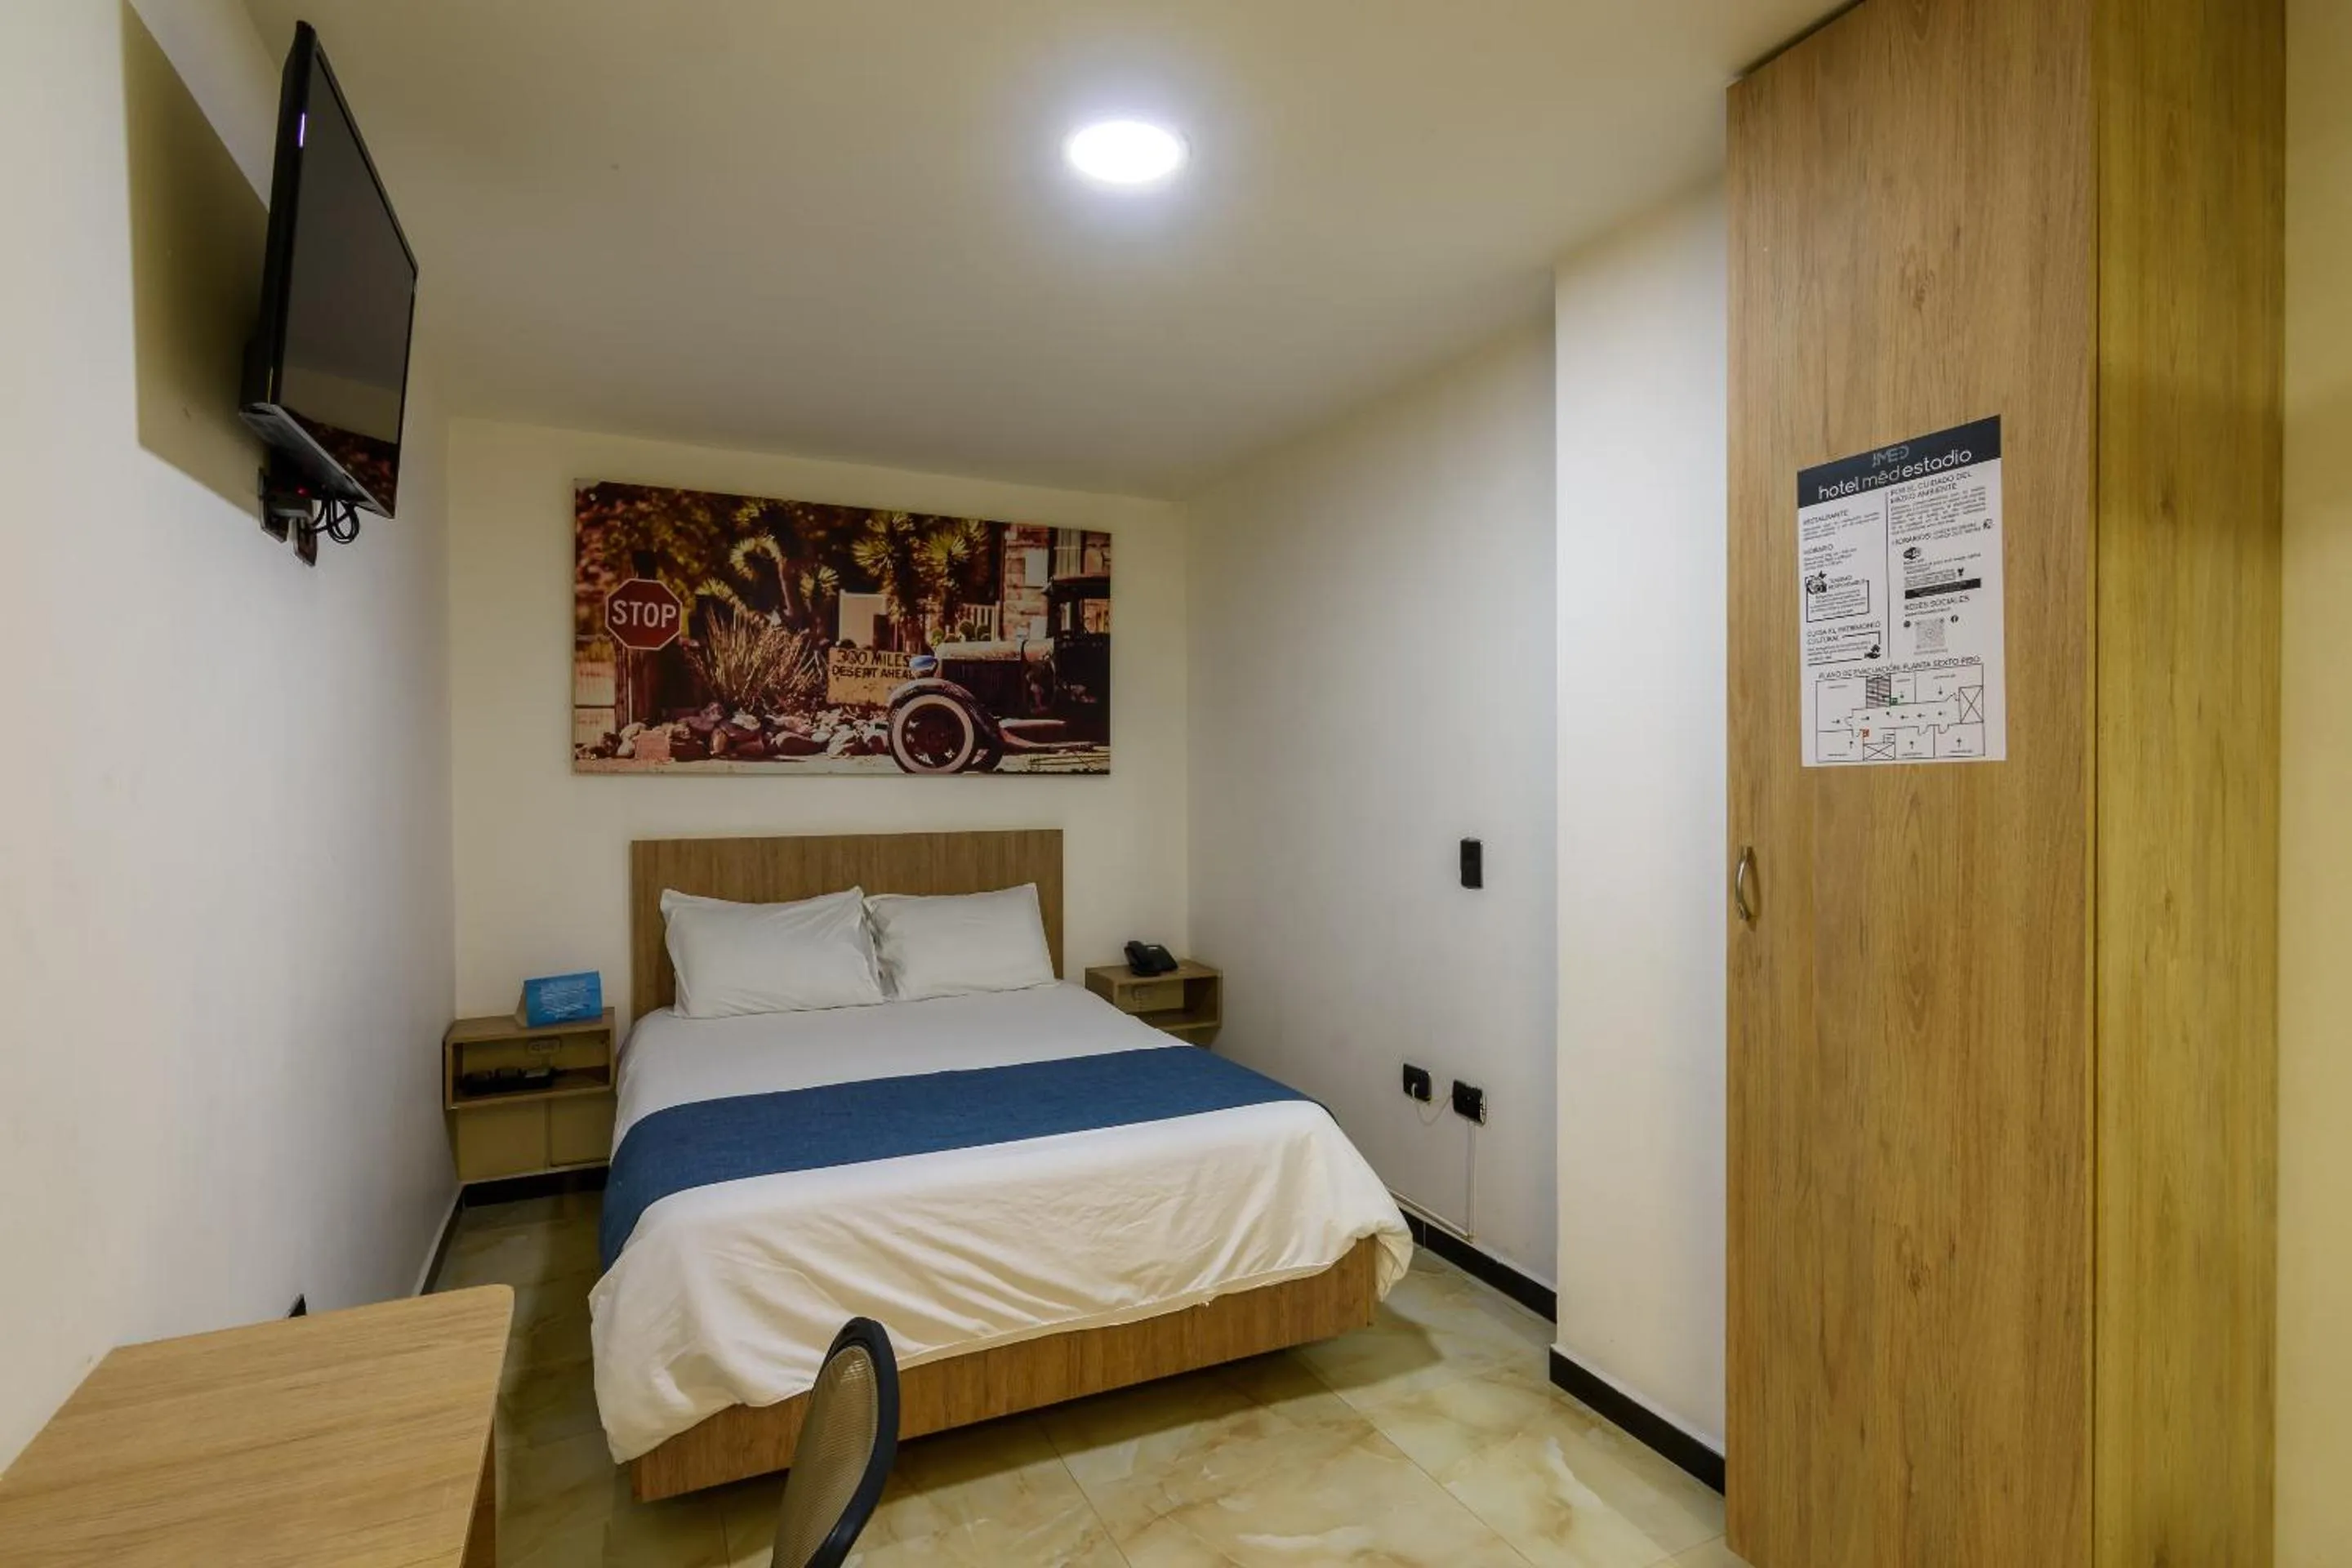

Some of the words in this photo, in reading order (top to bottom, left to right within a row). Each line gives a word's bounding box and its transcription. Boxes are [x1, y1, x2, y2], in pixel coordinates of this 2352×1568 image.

[1818, 476, 1860, 500] hotel
[612, 599, 676, 628] STOP
[872, 653, 911, 667] MILES
[1933, 658, 1958, 666] SEXTO
[832, 665, 878, 678] DESERT
